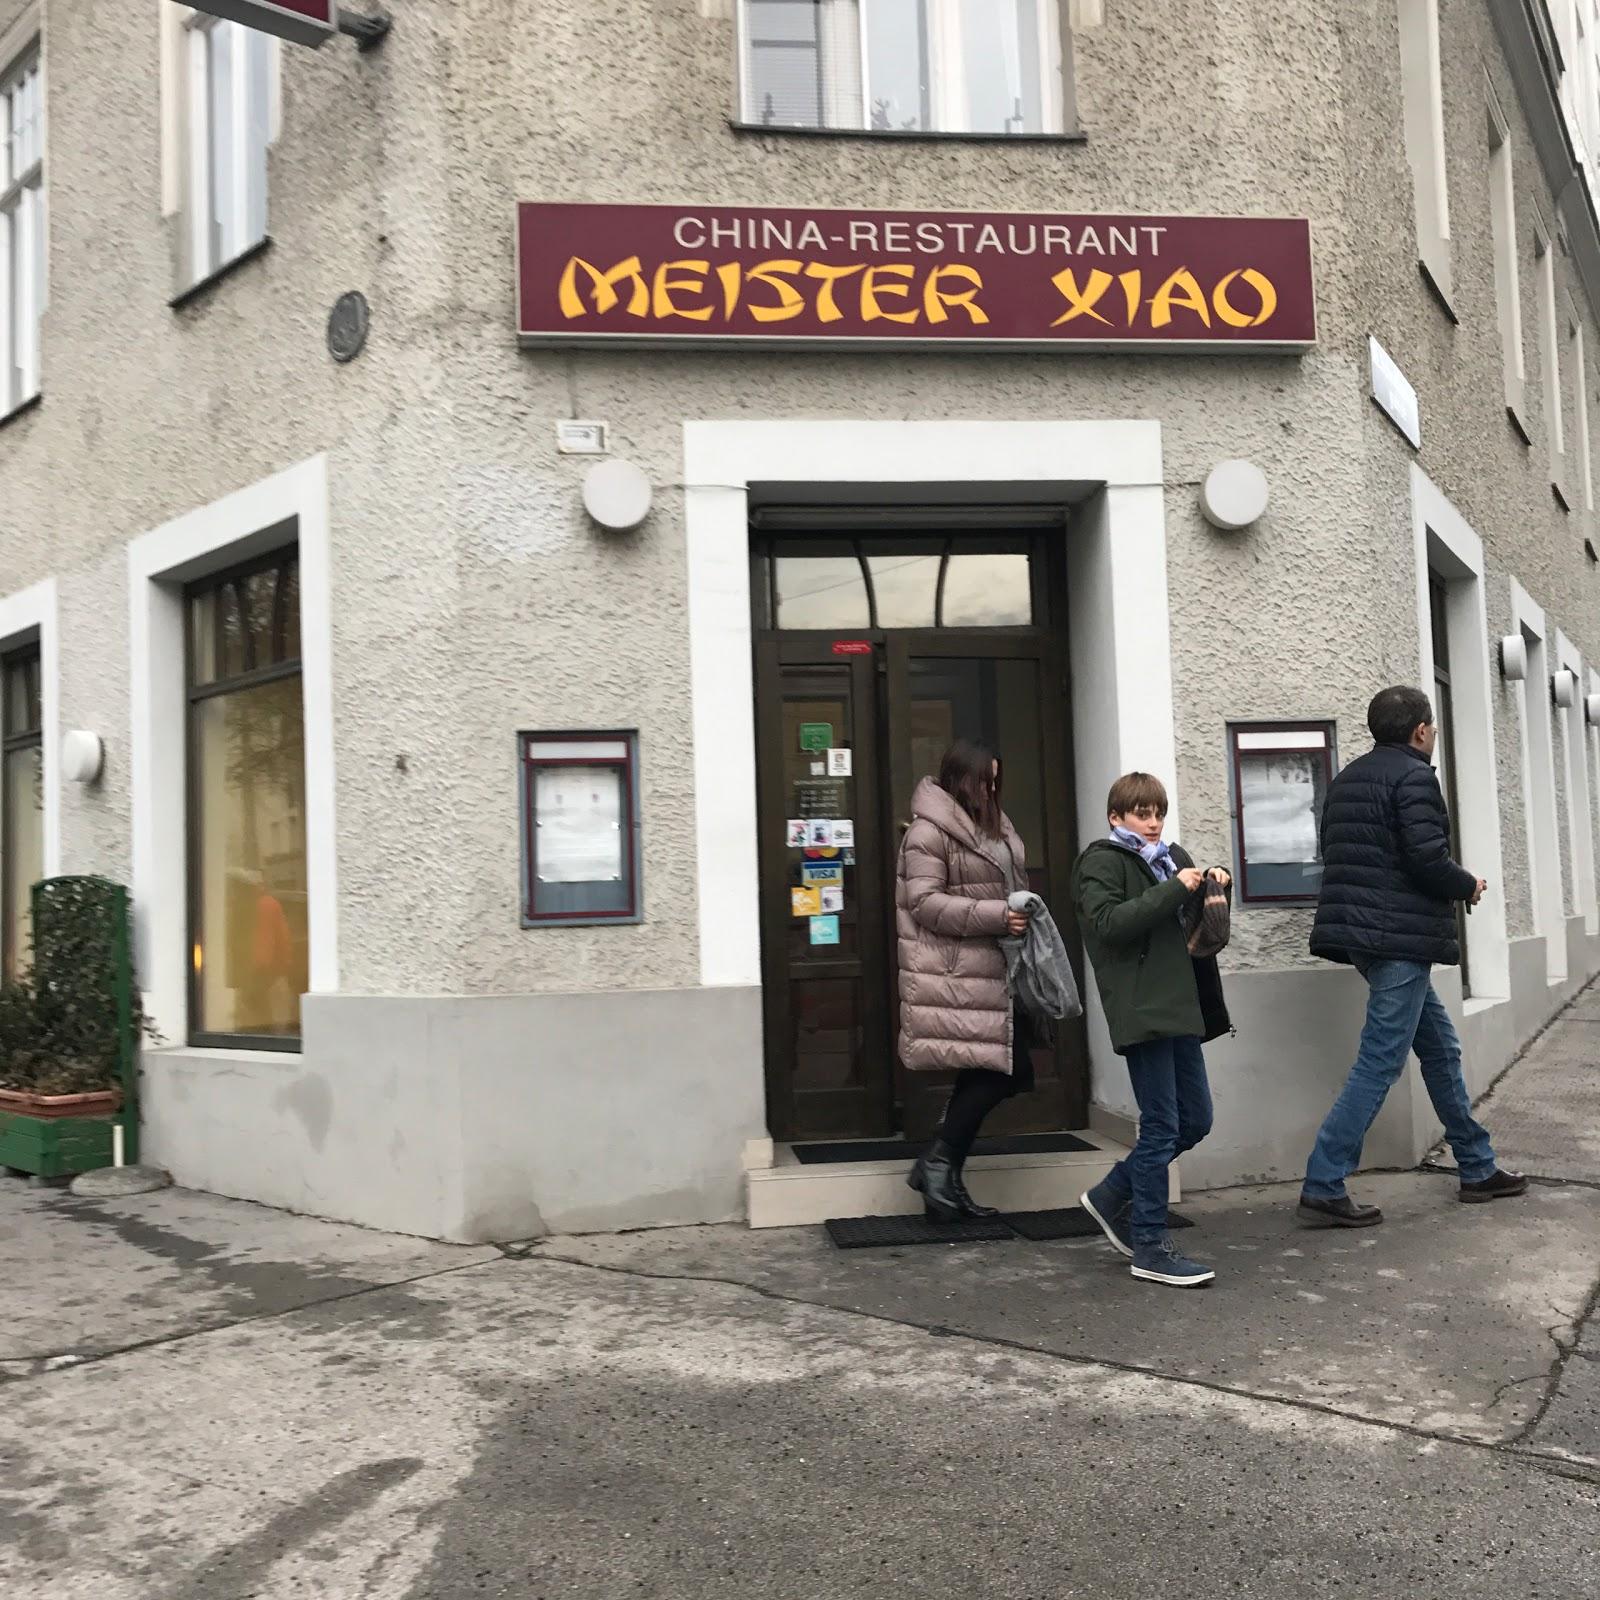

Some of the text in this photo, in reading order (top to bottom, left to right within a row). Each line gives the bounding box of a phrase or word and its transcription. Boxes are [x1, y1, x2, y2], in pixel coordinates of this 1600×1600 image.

[673, 216, 1167, 257] CHINA-RESTAURANT
[558, 255, 1278, 328] MEISTER XIAO
[808, 868, 837, 880] VISA
